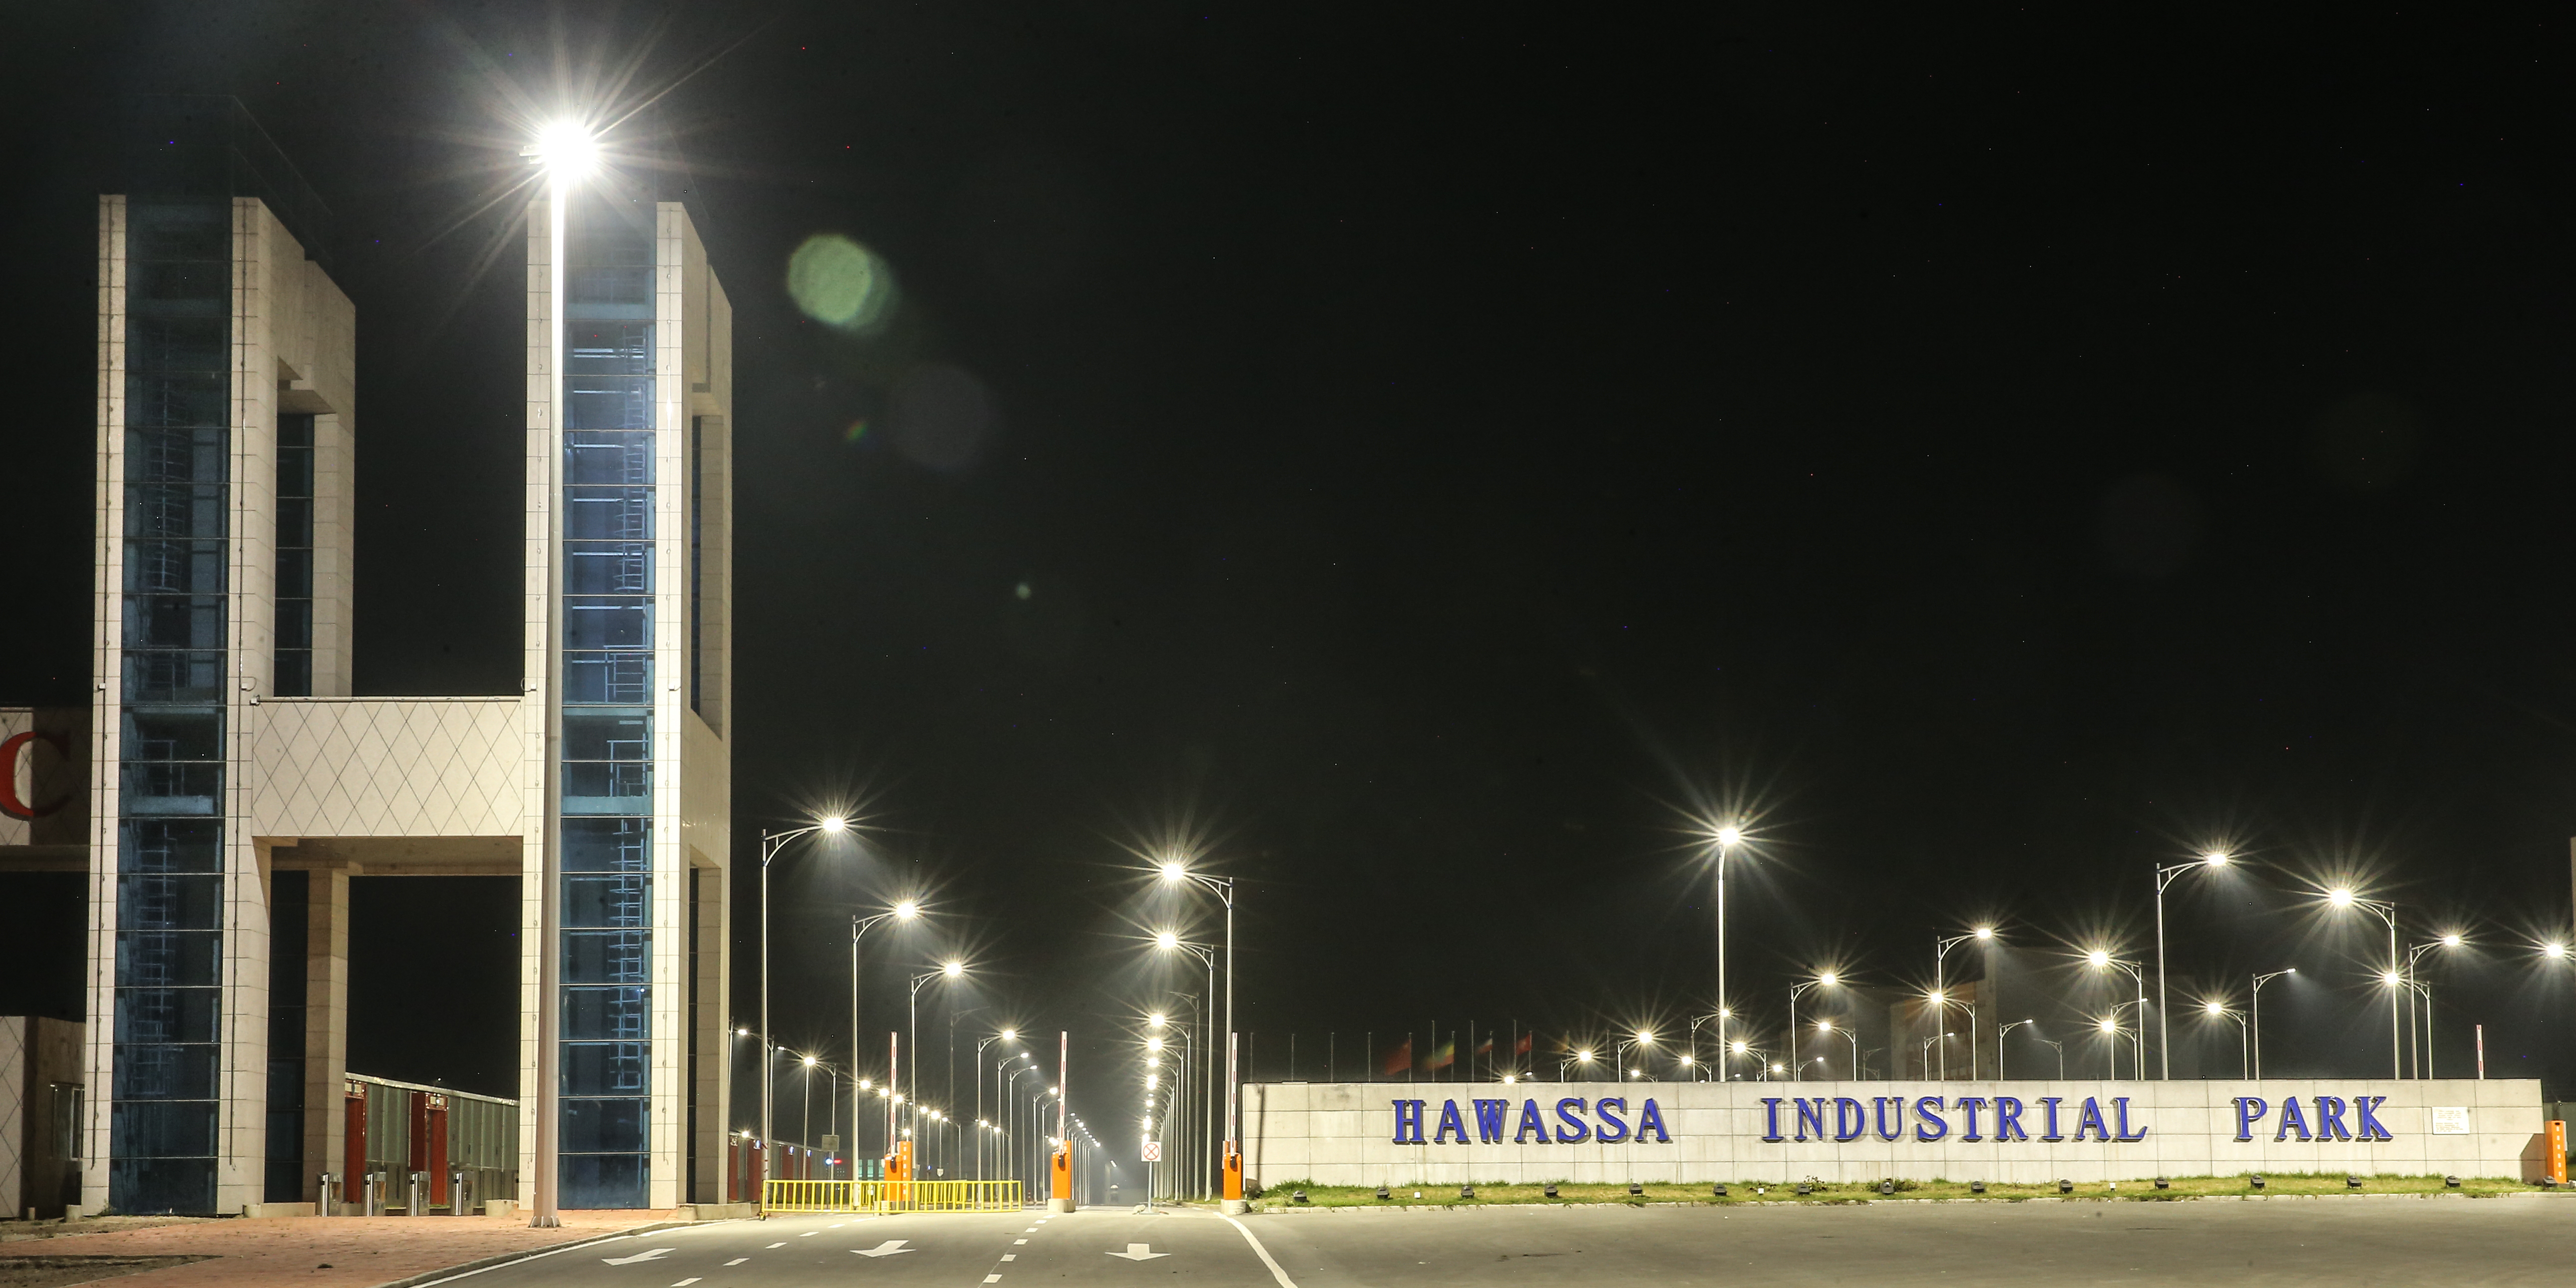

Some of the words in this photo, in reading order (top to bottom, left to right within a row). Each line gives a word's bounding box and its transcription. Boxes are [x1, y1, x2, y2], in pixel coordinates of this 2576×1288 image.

[1392, 1098, 1671, 1142] HAWASSA
[1760, 1096, 2148, 1141] INDUSTRIAL
[2234, 1096, 2393, 1140] PARK
